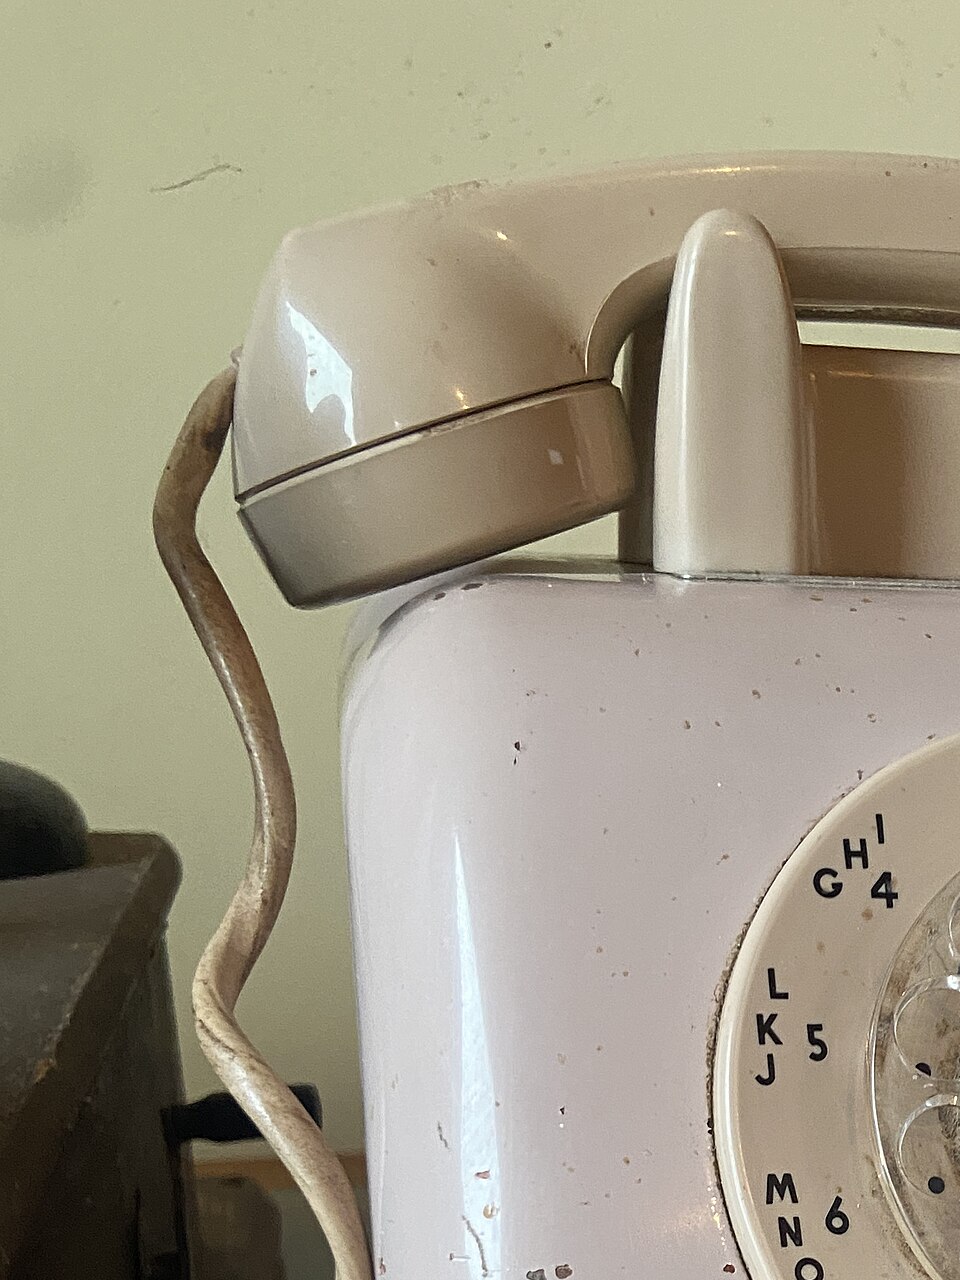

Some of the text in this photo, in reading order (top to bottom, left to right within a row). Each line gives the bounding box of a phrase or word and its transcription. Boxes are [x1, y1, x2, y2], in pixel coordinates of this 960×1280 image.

[870, 871, 898, 908] 4
[807, 1024, 828, 1061] 5
[825, 1195, 849, 1235] 6
